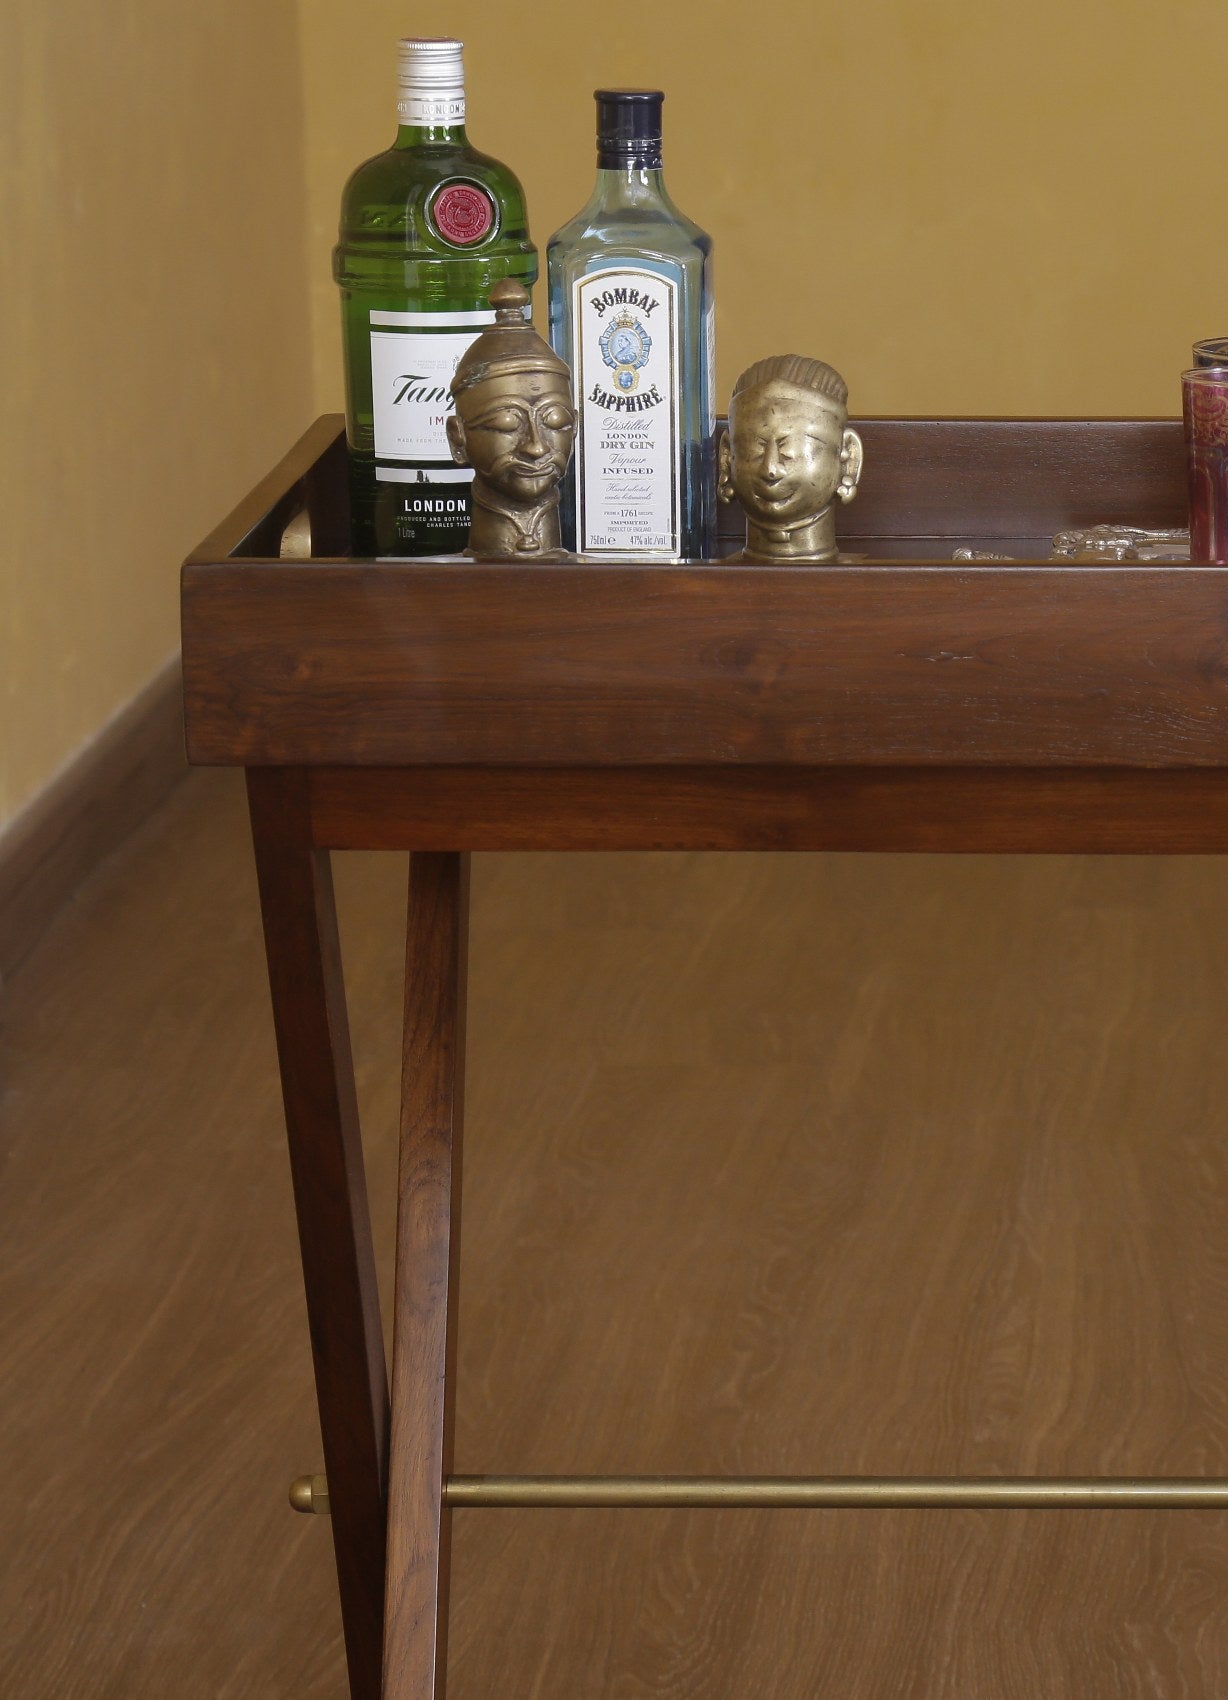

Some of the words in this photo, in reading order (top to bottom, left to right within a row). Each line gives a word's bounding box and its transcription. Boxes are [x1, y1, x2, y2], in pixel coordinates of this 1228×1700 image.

[589, 287, 660, 318] BOMBAY
[588, 383, 663, 413] SAPPHIRE
[601, 416, 654, 431] Distilled
[600, 441, 627, 449] DRY
[629, 441, 656, 449] GIN
[608, 453, 647, 466] Vapour
[404, 499, 466, 512] LONDON
[621, 509, 638, 517] 1761
[402, 527, 416, 538] Litre
[590, 535, 607, 545] 750ml
[630, 535, 643, 545] 47%
